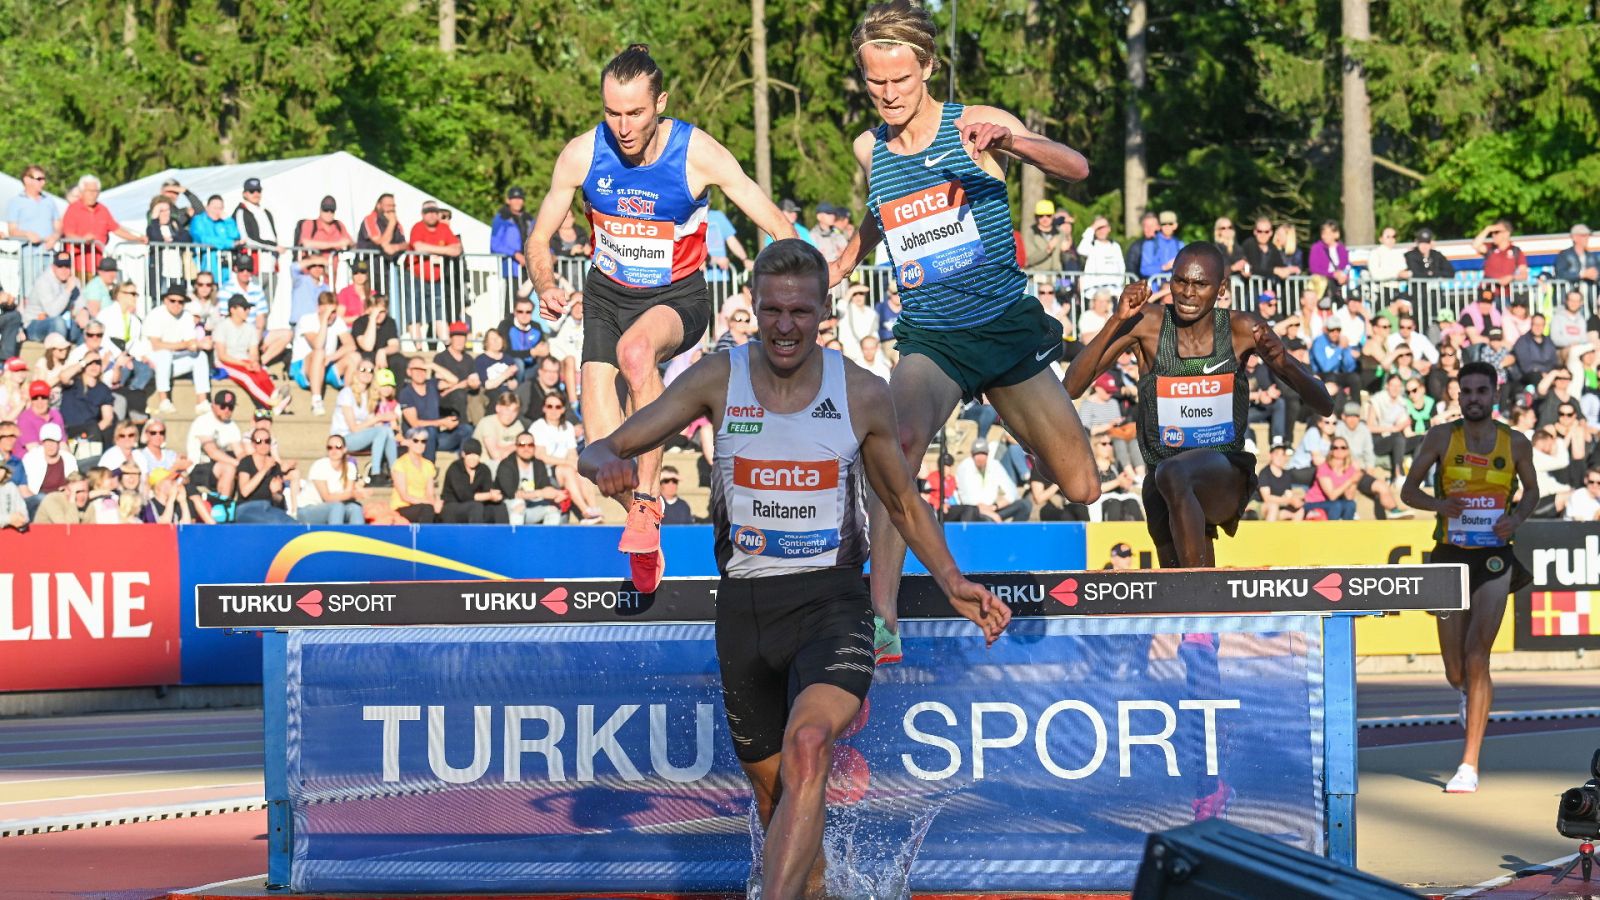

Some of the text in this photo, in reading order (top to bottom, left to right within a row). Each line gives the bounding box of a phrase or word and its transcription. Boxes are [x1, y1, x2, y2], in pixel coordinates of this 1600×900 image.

[627, 189, 659, 200] STEPHENS
[617, 196, 656, 216] SSH
[894, 192, 949, 223] renta
[604, 220, 658, 236] renta
[901, 221, 964, 251] Johansson
[600, 234, 665, 260] Buckingham
[931, 249, 974, 269] Continental
[955, 257, 973, 269] Gold
[902, 266, 921, 281] PNG
[1170, 379, 1221, 396] renta
[727, 404, 765, 418] renta
[811, 410, 842, 420] adidas
[1180, 405, 1213, 418] Kones
[730, 423, 760, 433] FEELIA
[1192, 428, 1226, 440] Continental
[1164, 432, 1182, 441] PNG
[751, 466, 820, 487] renta
[753, 500, 816, 519] Raitanen
[1460, 496, 1496, 508] enta
[1461, 514, 1492, 525] Boutera
[737, 533, 763, 547] PNG
[778, 538, 826, 547] Continental
[782, 546, 822, 555] Tour Gold
[986, 581, 1157, 603] RKU SPORT
[1227, 576, 1424, 598] TURKU SPORT
[0, 572, 153, 640] LINE
[219, 594, 396, 613] TURKU SPORT
[461, 591, 642, 611] TURKU SPORT
[363, 699, 1240, 784] TURKU SPORT
